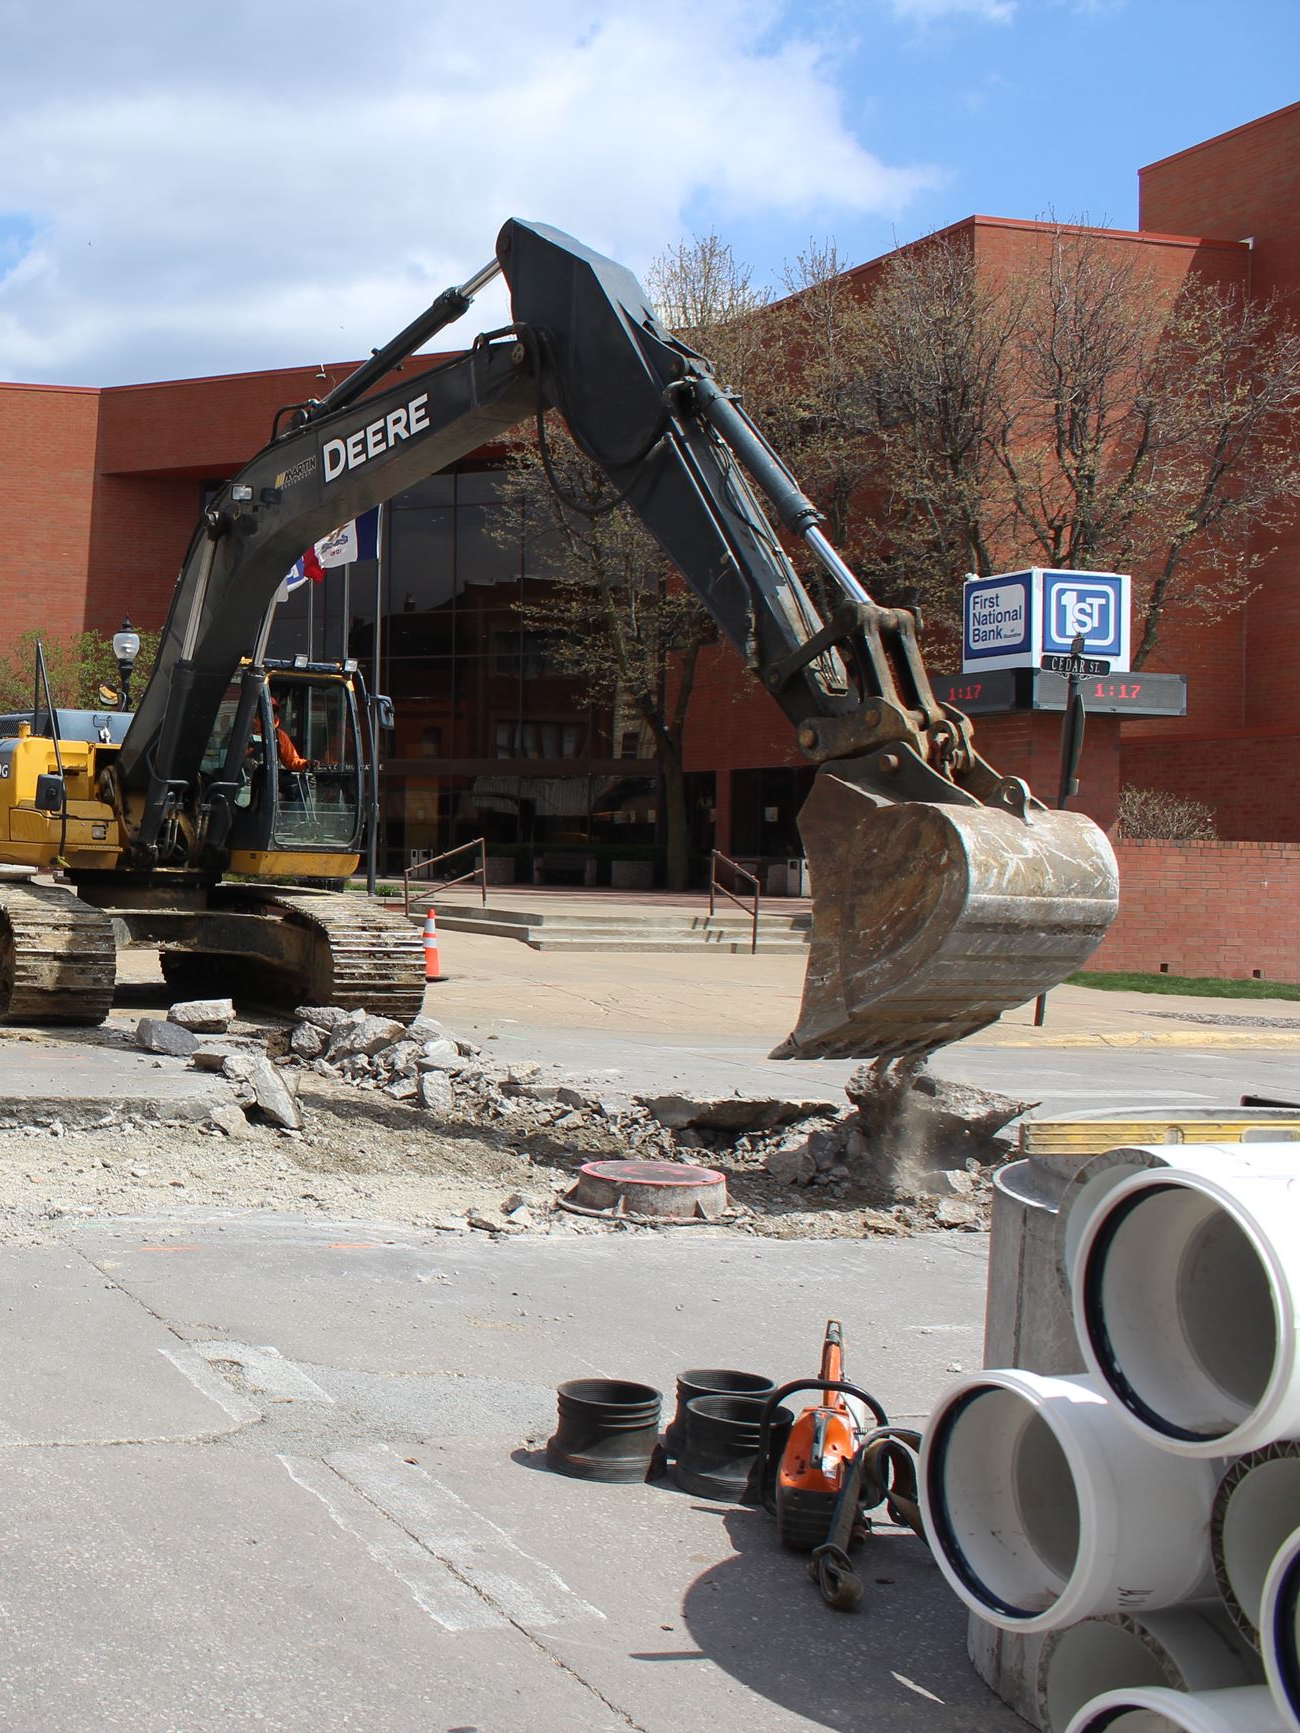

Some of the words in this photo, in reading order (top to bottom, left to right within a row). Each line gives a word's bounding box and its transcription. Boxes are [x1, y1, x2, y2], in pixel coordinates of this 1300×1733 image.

[322, 393, 430, 483] DEERE
[284, 455, 317, 483] MARTIN
[972, 593, 1000, 611] First
[972, 605, 1022, 627] National
[972, 625, 1003, 643] Bank
[1051, 657, 1085, 673] CEDAR
[1089, 661, 1101, 673] ST.
[949, 684, 982, 701] 1:17
[1094, 683, 1142, 699] 1:17
